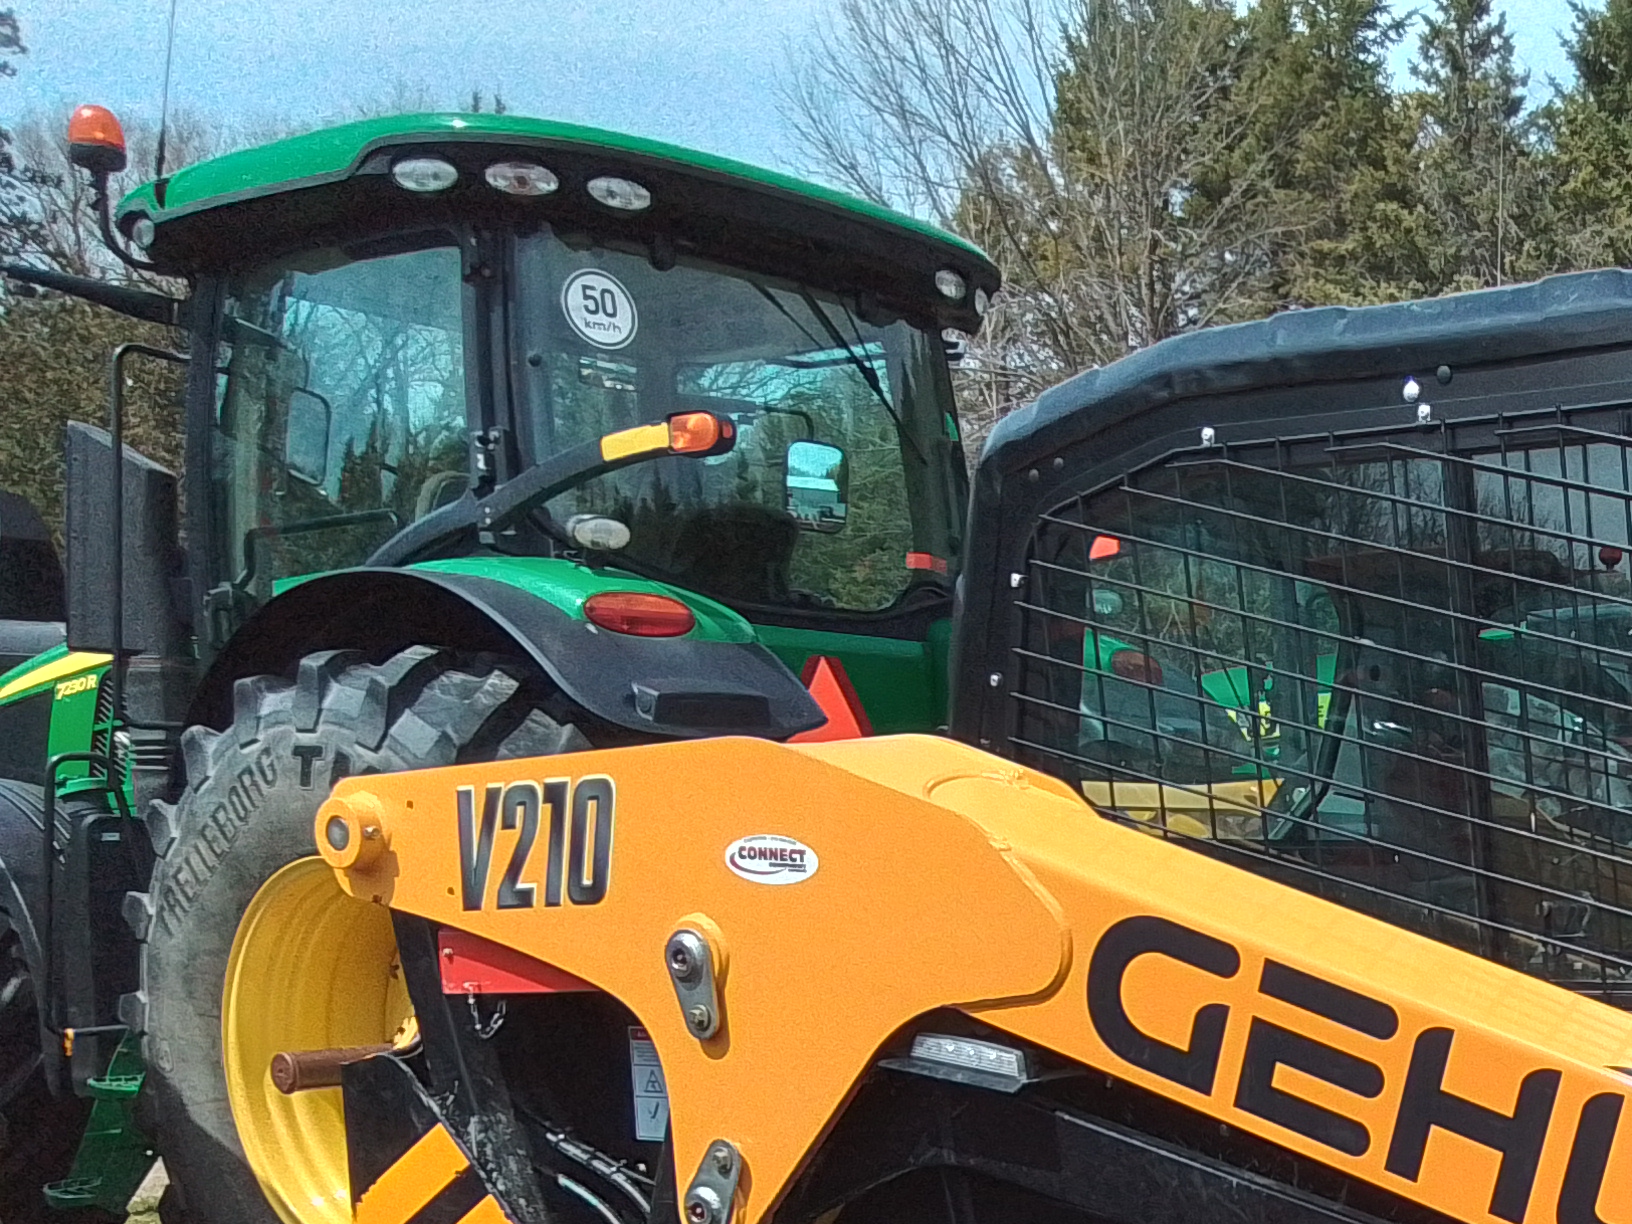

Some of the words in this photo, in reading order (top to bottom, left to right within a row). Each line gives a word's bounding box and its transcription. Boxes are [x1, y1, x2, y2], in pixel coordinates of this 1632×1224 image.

[581, 283, 618, 319] 50
[583, 317, 622, 335] km/h
[160, 746, 278, 937] TRELLEBORG
[456, 774, 617, 912] V210
[737, 845, 806, 863] CONNECT
